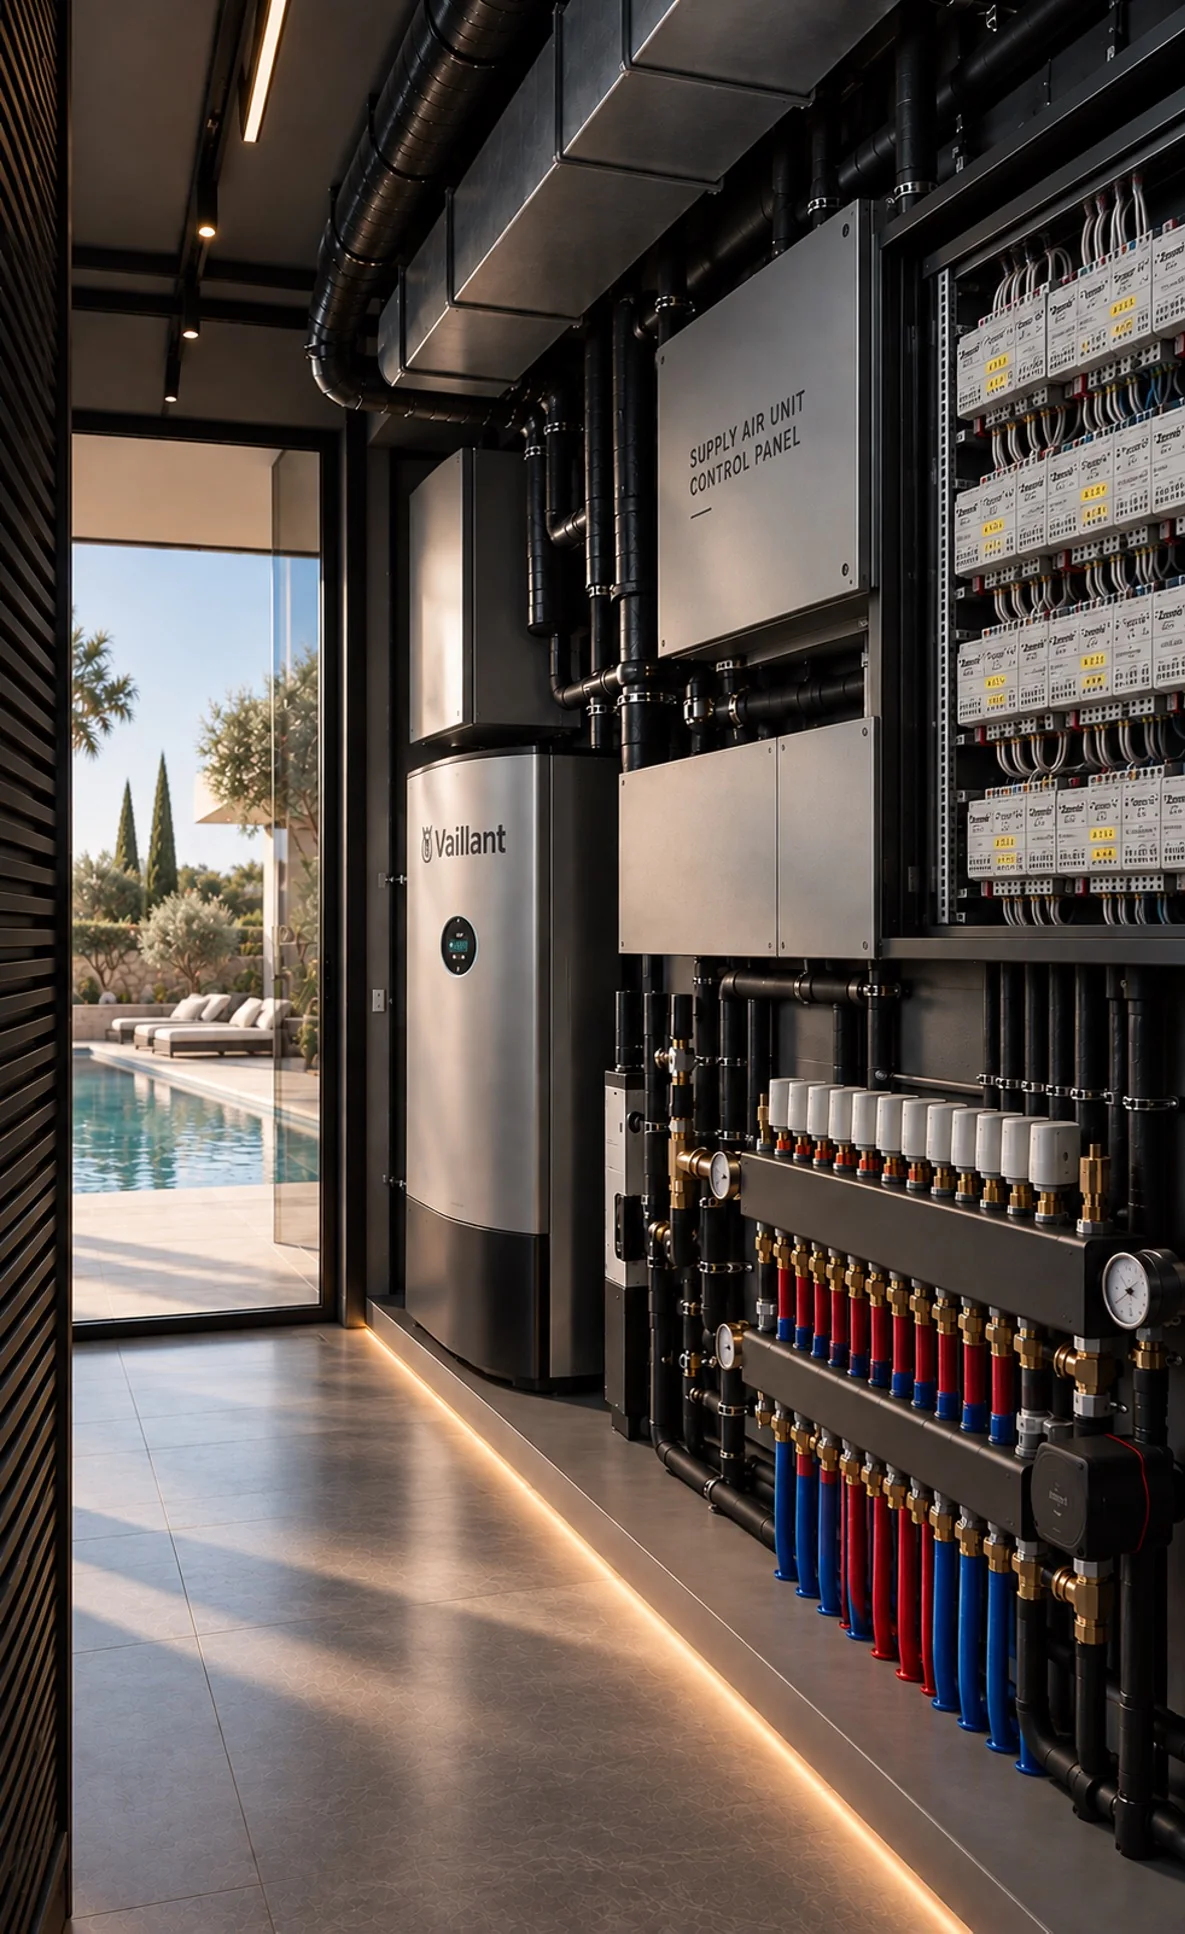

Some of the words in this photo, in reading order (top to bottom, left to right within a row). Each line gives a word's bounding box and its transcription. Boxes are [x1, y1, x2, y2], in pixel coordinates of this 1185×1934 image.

[690, 425, 738, 468] SUPPLY
[741, 412, 765, 442] AIR
[770, 389, 806, 426] UNIT
[690, 451, 750, 497] CONTROL
[755, 426, 801, 465] PANEL
[435, 824, 507, 858] Vaillant
